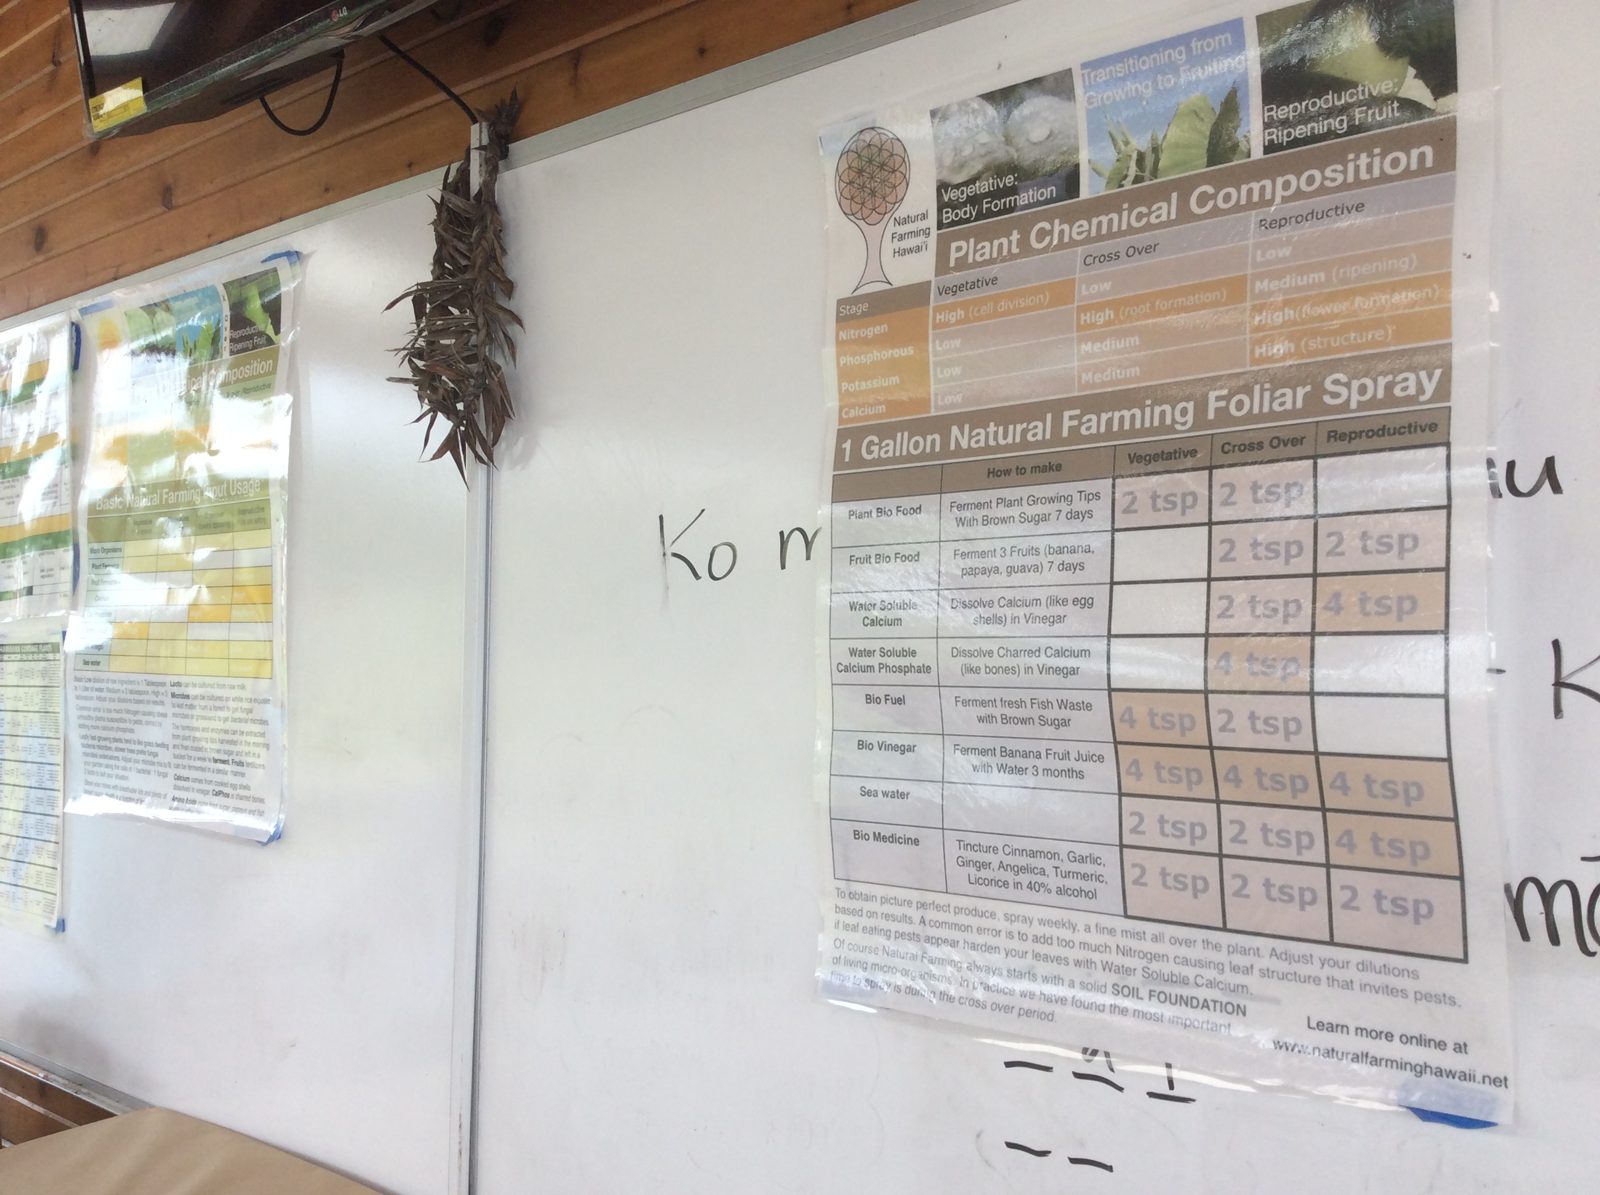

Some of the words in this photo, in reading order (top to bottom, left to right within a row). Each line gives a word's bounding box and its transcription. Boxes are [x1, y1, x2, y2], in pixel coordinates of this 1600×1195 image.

[1082, 46, 1186, 85] Transitioning
[1191, 31, 1232, 55] from
[1085, 79, 1152, 109] Growing
[1157, 74, 1174, 90] to
[1264, 78, 1399, 122] Reproductive:
[1264, 116, 1348, 146] Ripening
[1355, 101, 1400, 125] Fruit
[941, 173, 1019, 202] Vegetative:
[893, 210, 929, 227] Natural
[942, 203, 978, 224] Body
[982, 185, 1056, 211] Formation
[949, 230, 1020, 267] Plant
[1030, 182, 1177, 248] Chemical
[1189, 143, 1434, 208] Composition
[891, 226, 930, 244] Farming
[839, 302, 869, 316] Stage
[937, 275, 998, 296] Vegetative
[1083, 253, 1120, 266] Cross
[1126, 242, 1159, 258] Over
[1259, 202, 1365, 231] Reproductive
[839, 325, 888, 341] Nitrogen
[936, 309, 965, 323] High
[969, 303, 993, 319] (cell
[997, 291, 1050, 312] division)
[1081, 281, 1112, 295] Low
[1257, 245, 1292, 262] Low
[840, 346, 913, 367] Phosphorous
[1080, 309, 1114, 324] High
[1119, 299, 1150, 320] (root
[1155, 288, 1227, 311] formation)
[1255, 271, 1325, 293] Medium
[1332, 253, 1417, 283] (ripening)
[842, 375, 899, 393] Potassium
[1081, 335, 1139, 354] Medium
[842, 404, 886, 418] Calcium
[1082, 366, 1140, 384] Medium
[1255, 341, 1295, 358] High
[1301, 326, 1392, 352] (structure)
[841, 439, 851, 462] 1
[861, 433, 940, 460] Gallon
[950, 413, 1052, 451] Natural
[1062, 399, 1194, 438] Farming
[1208, 384, 1312, 420] Foliar
[1322, 369, 1443, 410] Spray
[987, 467, 1012, 479] How
[1016, 464, 1026, 476] to
[1030, 461, 1062, 475] make
[1128, 448, 1198, 465] Vegetative
[1221, 441, 1264, 455] Cross
[1269, 434, 1306, 449] Over
[1326, 421, 1438, 443] Reproductive
[163, 487, 201, 505] Farming
[230, 479, 261, 496] Usage
[950, 500, 993, 513] Ferment
[996, 497, 1023, 509] Plant
[1027, 493, 1073, 507] Growing
[1077, 490, 1101, 503] Tips
[1121, 491, 1138, 514] 2
[1150, 490, 1198, 517] tsp
[1220, 482, 1237, 506] 2
[1250, 480, 1304, 508] tsp
[848, 510, 873, 520] Plant
[876, 507, 893, 518] Bio
[895, 504, 922, 517] Food
[955, 516, 979, 528] With
[982, 515, 1015, 527] Brown
[1019, 512, 1051, 525] Sugar
[1055, 509, 1062, 521] 7
[1065, 508, 1093, 522] days
[658, 508, 738, 582] Ko
[849, 555, 871, 565] Fruit
[874, 553, 891, 564] Bio
[894, 552, 920, 563] Food
[1219, 538, 1237, 563] 2
[1250, 537, 1304, 566] tsp
[1326, 532, 1345, 557] 2
[1360, 530, 1420, 559] tsp
[1324, 592, 1344, 616] 4
[1359, 591, 1418, 621] tsp
[848, 647, 877, 658] Water
[879, 647, 917, 657] Soluble
[951, 646, 994, 658] Dissolve
[997, 646, 1041, 659] Charred
[1047, 646, 1091, 659] Calcium
[836, 662, 876, 674] Calcium
[878, 663, 931, 676] Phosphate
[961, 664, 982, 676] (like
[985, 663, 1020, 677] bones)
[1024, 664, 1034, 675] in
[1037, 665, 1081, 678] Vinegar
[865, 694, 882, 704] Bio
[884, 694, 906, 705] Fuel
[1119, 707, 1137, 729] 4
[1146, 707, 1196, 737] tsp
[1217, 709, 1236, 733] 2
[1248, 709, 1302, 740] tsp
[857, 740, 874, 751] Bio
[877, 741, 917, 755] Vinegar
[859, 785, 879, 798] Sea
[881, 787, 910, 800] water
[1330, 771, 1350, 796] 4
[1364, 773, 1424, 807] tsp
[853, 829, 870, 842] Bio
[873, 831, 920, 846] Medicine
[956, 839, 999, 855] Tincture
[1002, 844, 1064, 862] Cinnamon,
[1067, 850, 1106, 867] Garlic,
[956, 856, 995, 872] Ginger,
[997, 860, 1050, 878] Angelica,
[1053, 866, 1108, 884] Turmeric,
[1131, 863, 1148, 887] 2
[1159, 865, 1210, 899] tsp
[968, 874, 1009, 890] Licorice
[1013, 879, 1023, 891] in
[1026, 882, 1052, 895] 40%
[1056, 885, 1098, 900] alcohol
[1340, 885, 1360, 911] 2
[1373, 889, 1435, 925] tsp
[835, 887, 845, 899] To
[849, 890, 877, 904] obtain
[880, 894, 913, 910] picture
[916, 899, 951, 914] perfect
[1003, 911, 1034, 928] spray
[1084, 924, 1091, 933] a
[1096, 922, 1117, 937] fine
[1121, 929, 1146, 942] mist
[1151, 931, 1165, 943] all
[1169, 936, 1197, 948] over
[1202, 939, 1222, 952] the
[1269, 947, 1314, 966] Adjust
[1318, 954, 1351, 971] your
[1356, 959, 1420, 980] dilutions
[1112, 984, 1144, 1001] SOIL
[1149, 989, 1247, 1017] FOUNDATION
[1307, 1016, 1350, 1036] Learn
[1355, 1025, 1394, 1043] more
[1399, 1033, 1448, 1051] online
[1453, 1040, 1469, 1055] at
